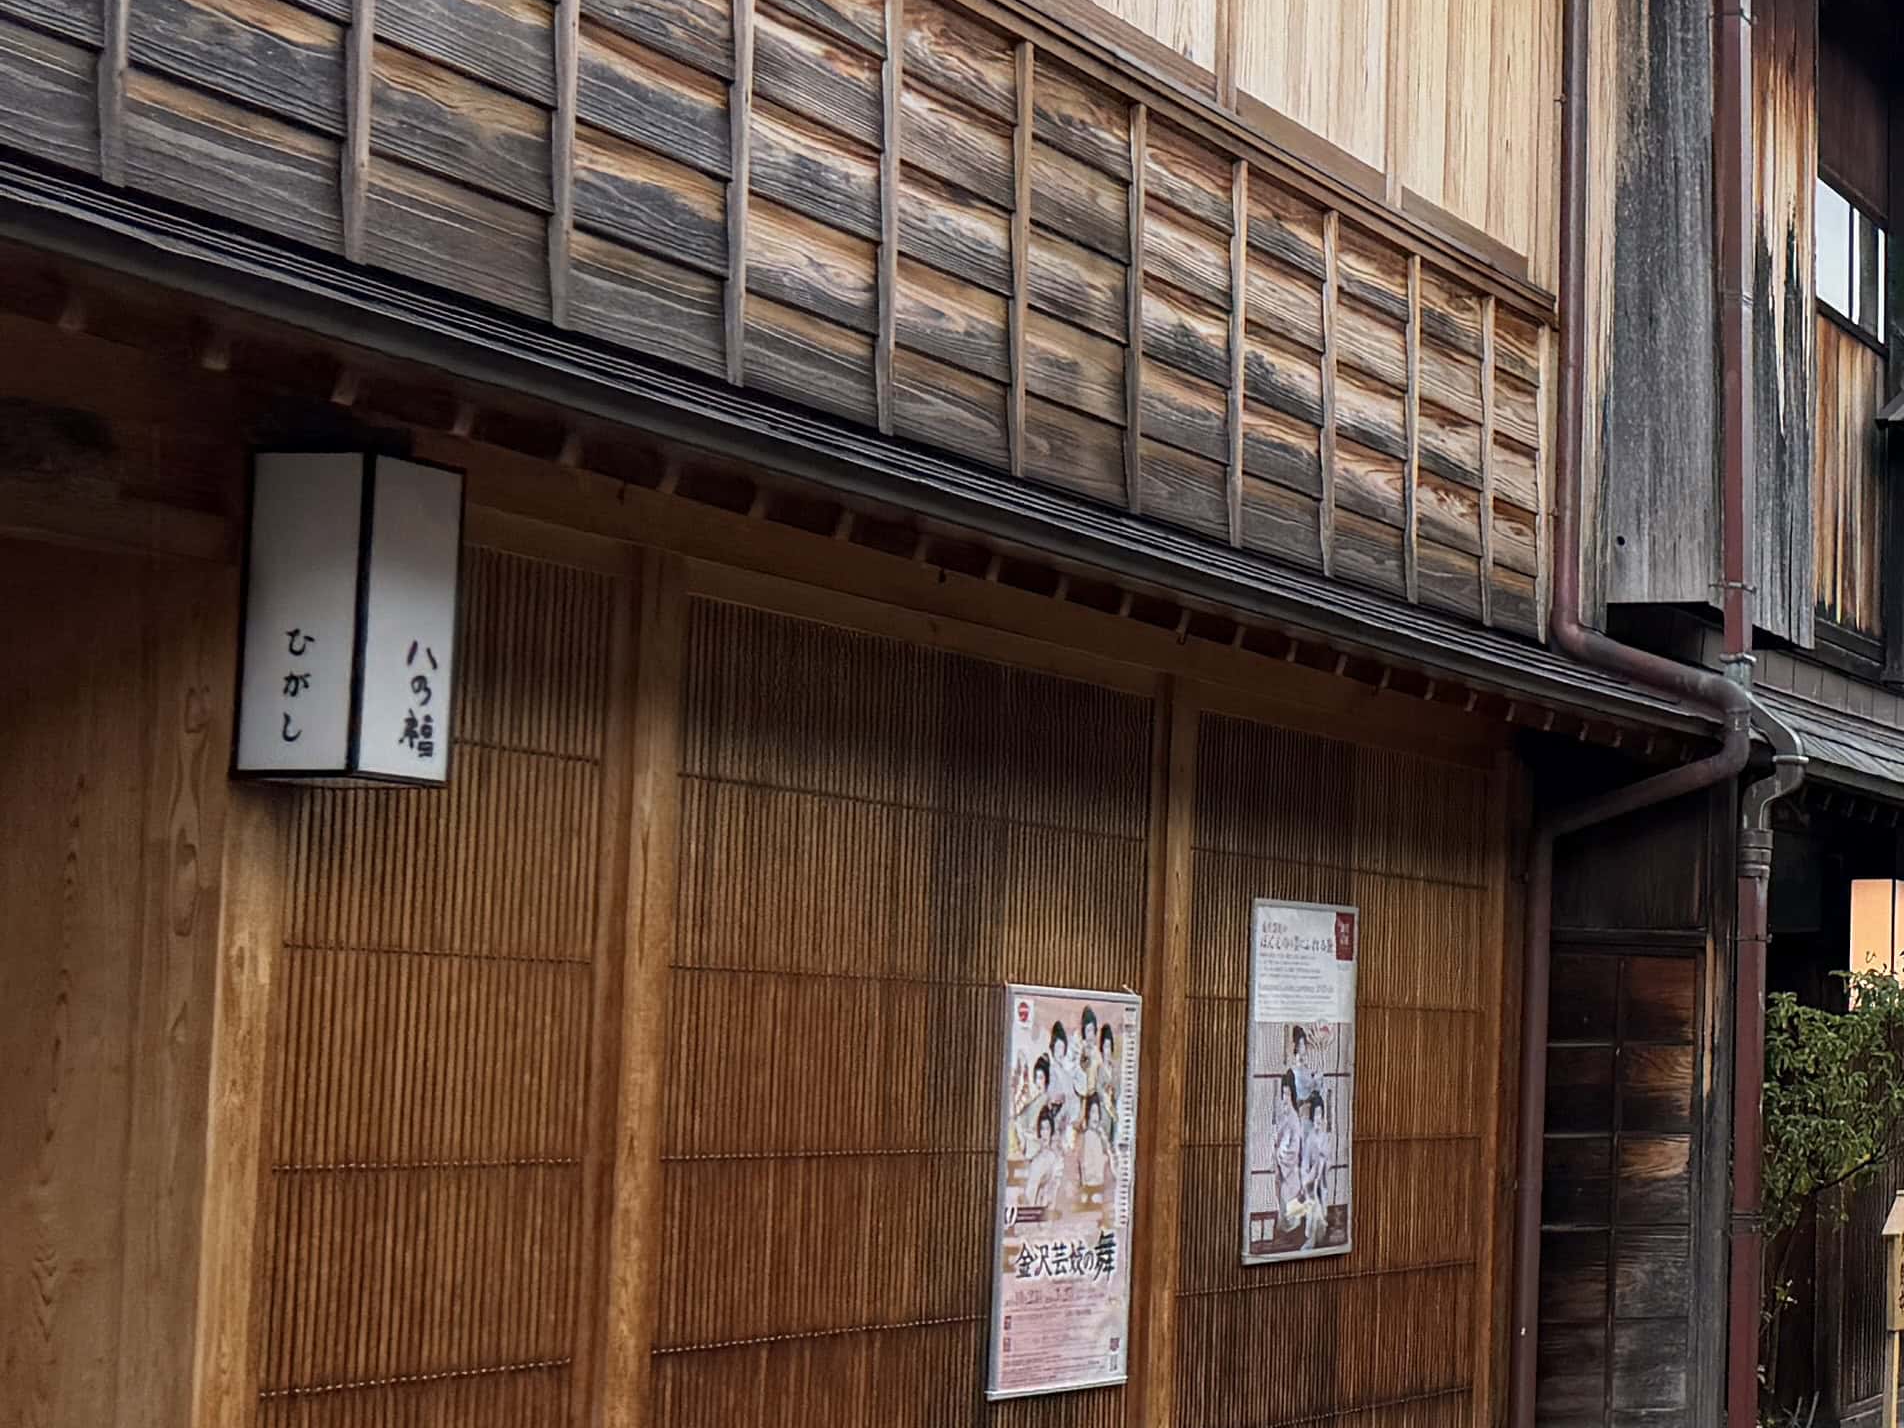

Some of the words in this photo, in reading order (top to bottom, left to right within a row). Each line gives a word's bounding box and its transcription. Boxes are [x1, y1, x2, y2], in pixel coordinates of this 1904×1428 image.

[282, 627, 316, 743] ひがし
[1015, 1230, 1117, 1283] 金沢芸妓の舞
